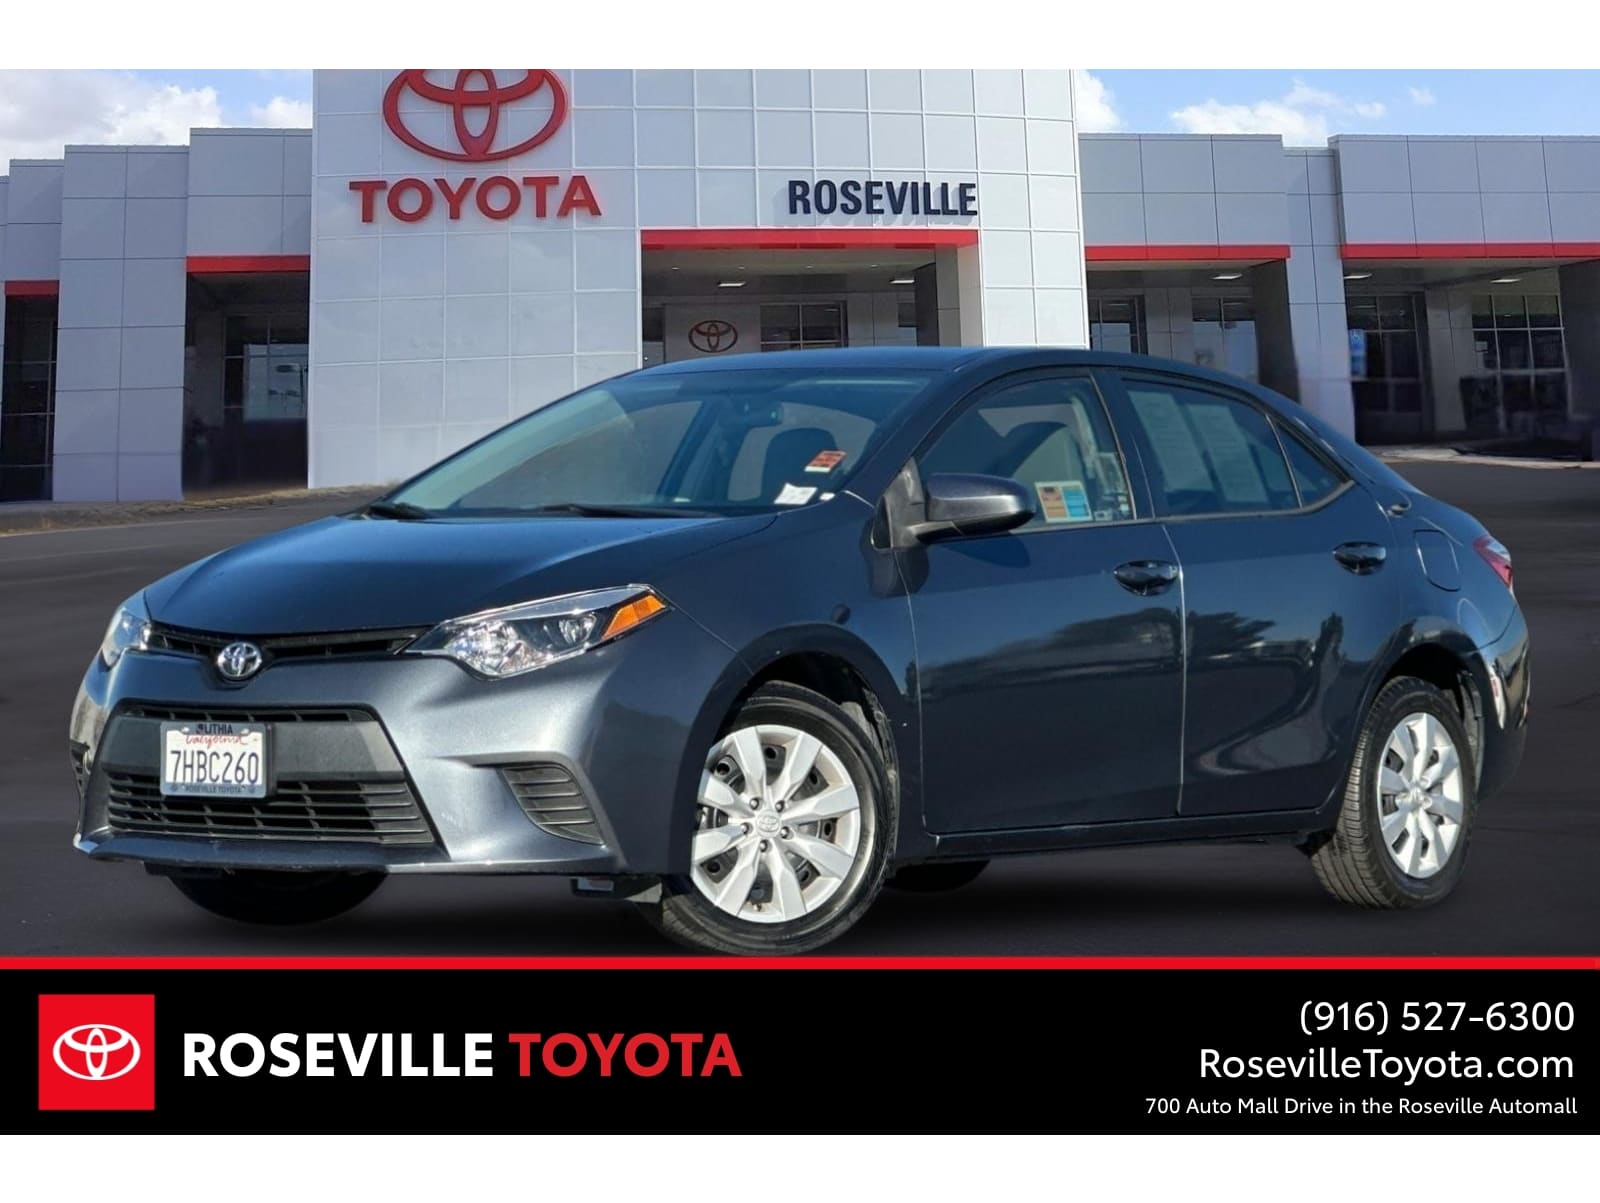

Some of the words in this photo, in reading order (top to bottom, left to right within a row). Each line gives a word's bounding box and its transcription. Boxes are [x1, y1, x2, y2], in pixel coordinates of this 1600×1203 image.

[349, 175, 602, 223] TOYOTA
[788, 180, 978, 216] ROSEVILLE
[170, 750, 259, 784] 7HBC260
